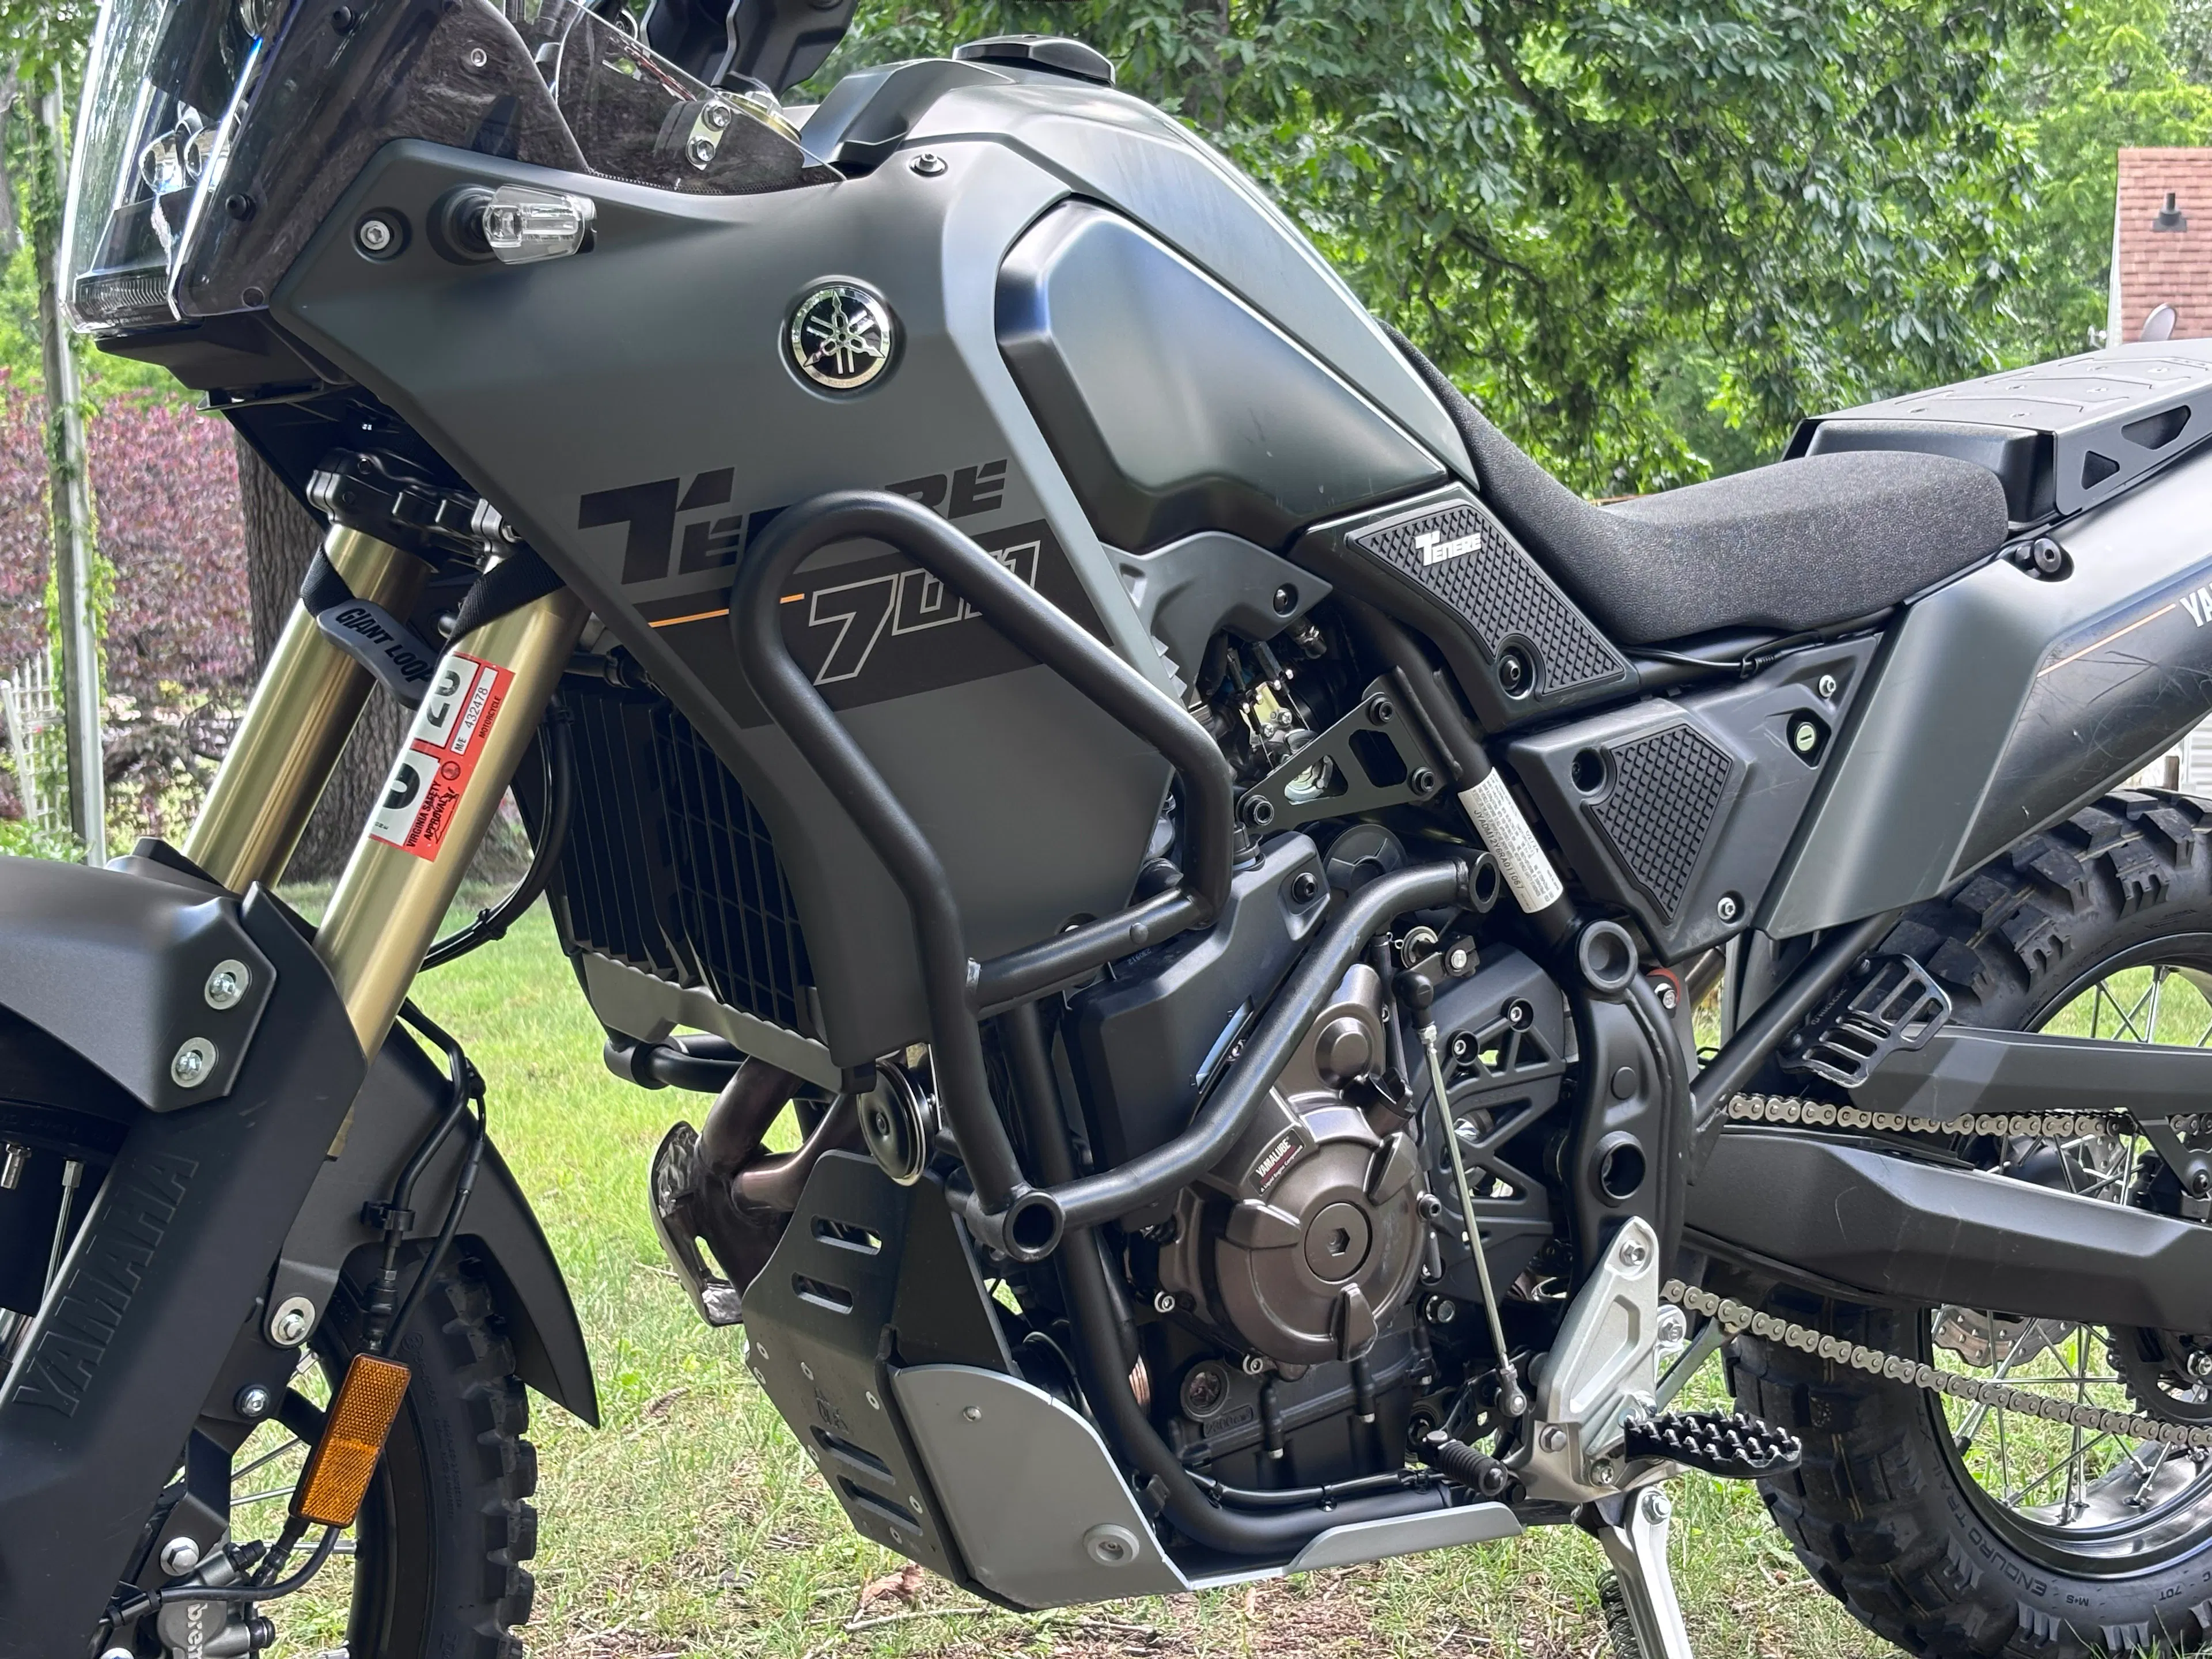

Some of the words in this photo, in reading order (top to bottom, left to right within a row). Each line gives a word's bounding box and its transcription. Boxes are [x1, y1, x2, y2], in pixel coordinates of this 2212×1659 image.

[2179, 582, 2212, 627] YA
[335, 608, 395, 644] GIANT
[384, 644, 435, 683] LOOP
[454, 737, 467, 752] M/E
[464, 687, 488, 729] 432478
[479, 696, 502, 738] MOTORCYCLE
[407, 812, 429, 847] VIRGINIA
[423, 781, 441, 812] SAFETY
[424, 798, 447, 841] APPROVAL
[1256, 1138, 1291, 1177] YAMALUBE
[12, 1154, 200, 1418] YAMAHA
[1968, 1527, 2047, 1597] ENDURO
[2158, 1585, 2182, 1601] 70T
